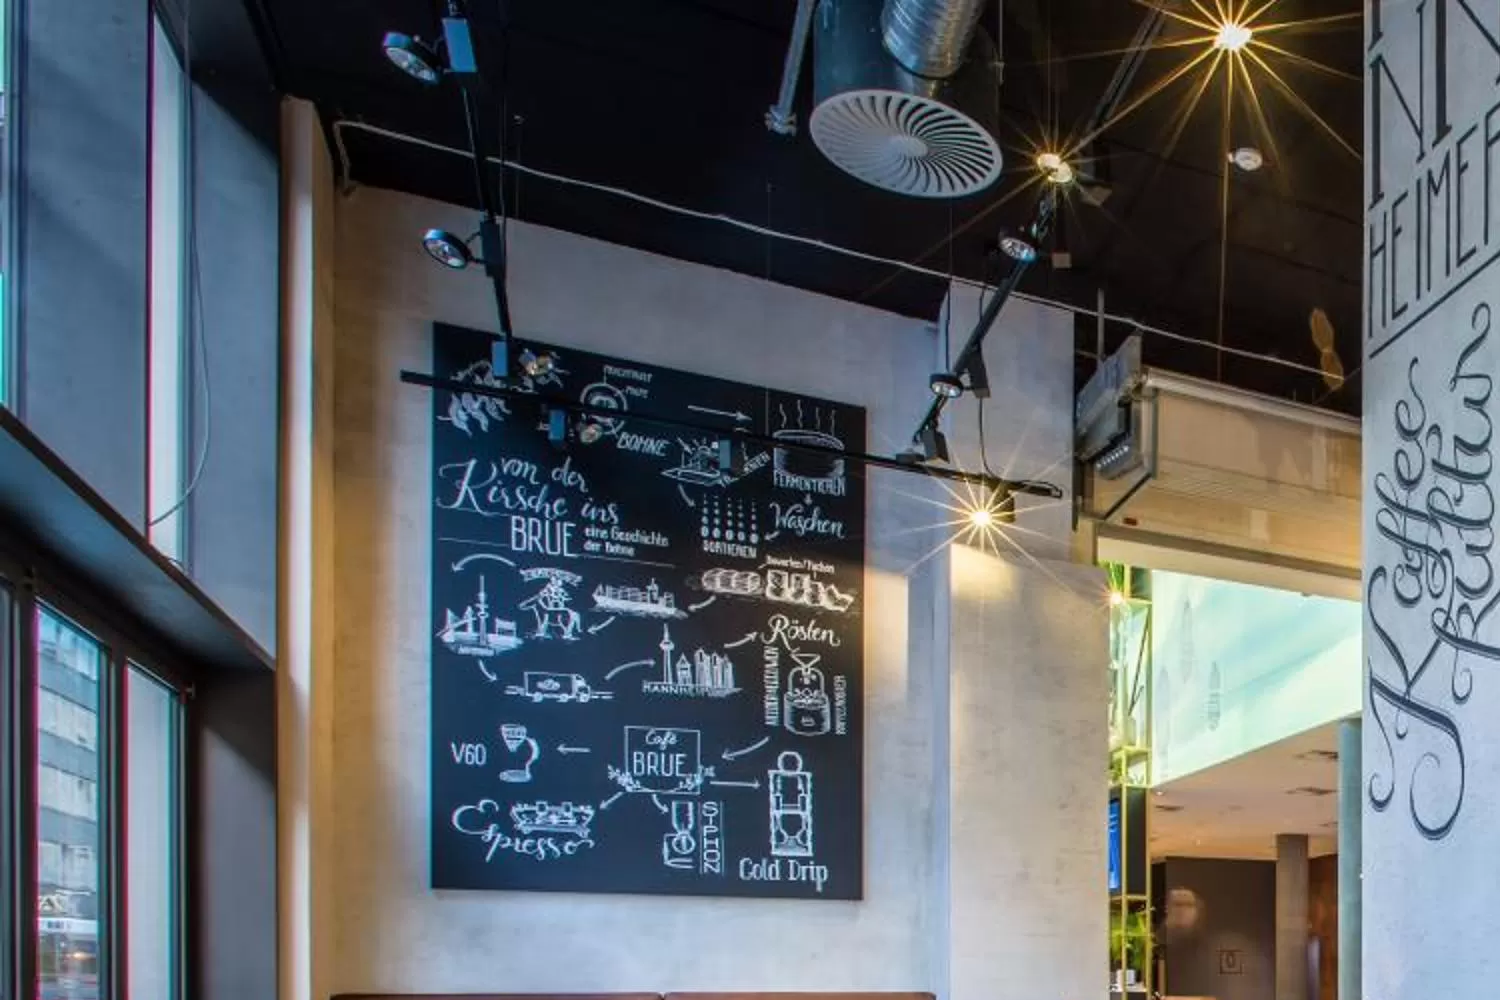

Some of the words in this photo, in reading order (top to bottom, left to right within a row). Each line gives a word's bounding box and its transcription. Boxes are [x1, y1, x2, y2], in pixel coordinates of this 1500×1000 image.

[616, 432, 672, 457] BOHNE
[436, 458, 570, 521] Kirsche
[580, 497, 622, 525] ins
[501, 457, 541, 485] von
[551, 456, 589, 493] der
[511, 515, 577, 557] BRUE
[584, 524, 609, 539] eine
[769, 502, 846, 540] Waschen
[1367, 356, 1465, 841] Kaffee
[761, 613, 842, 652] Rösten
[451, 741, 487, 766] V60
[633, 751, 687, 777] BRUE
[451, 799, 595, 863] Espresso
[738, 858, 781, 883] Cold
[788, 858, 829, 892] Drip
